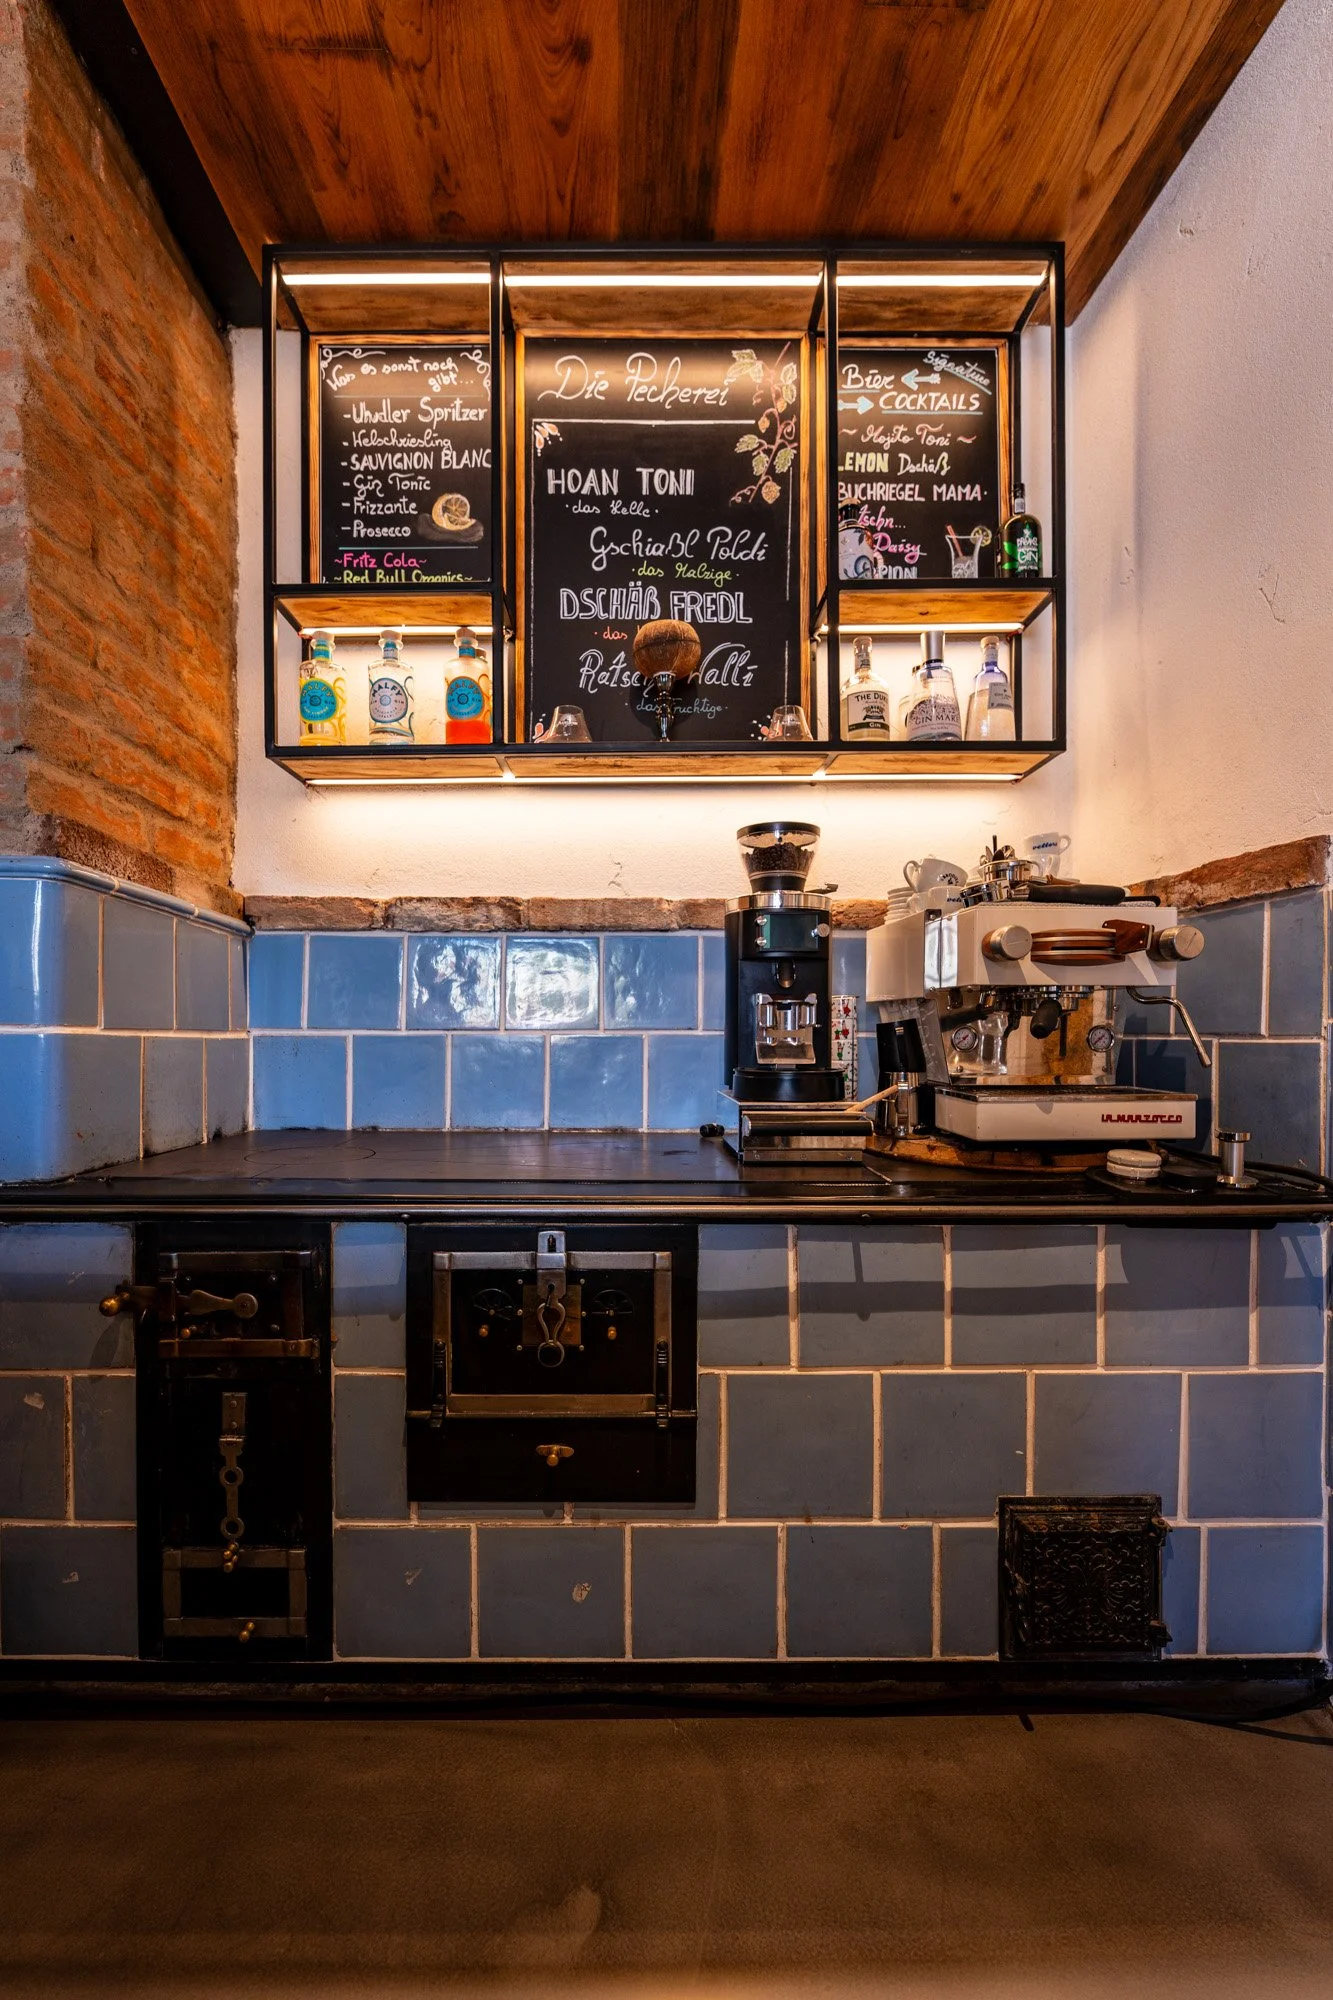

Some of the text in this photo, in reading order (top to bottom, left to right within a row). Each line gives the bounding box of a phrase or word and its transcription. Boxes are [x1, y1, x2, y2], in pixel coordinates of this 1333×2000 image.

[360, 363, 377, 375] es
[382, 356, 421, 374] sonst
[423, 357, 459, 373] noch
[537, 352, 737, 409] Die Pecherei
[841, 363, 895, 389] Bier
[879, 391, 981, 411] COCKTAILS
[418, 396, 488, 430] Spritzer
[861, 423, 951, 450] Mojito Toni
[441, 449, 491, 470] BLANC
[838, 452, 889, 473] EMON
[387, 472, 431, 491] Tonic
[546, 468, 695, 496] HOAN TONI
[572, 500, 601, 514] das
[706, 526, 769, 561] Poldi
[872, 532, 927, 565] Daisy
[1018, 550, 1038, 563] GIN
[376, 570, 405, 583] Bull
[637, 561, 665, 578] das
[670, 591, 753, 624] FREDL
[602, 626, 628, 640] das
[372, 682, 402, 697] MALFY
[855, 693, 871, 702] THE
[914, 715, 933, 725] GIN
